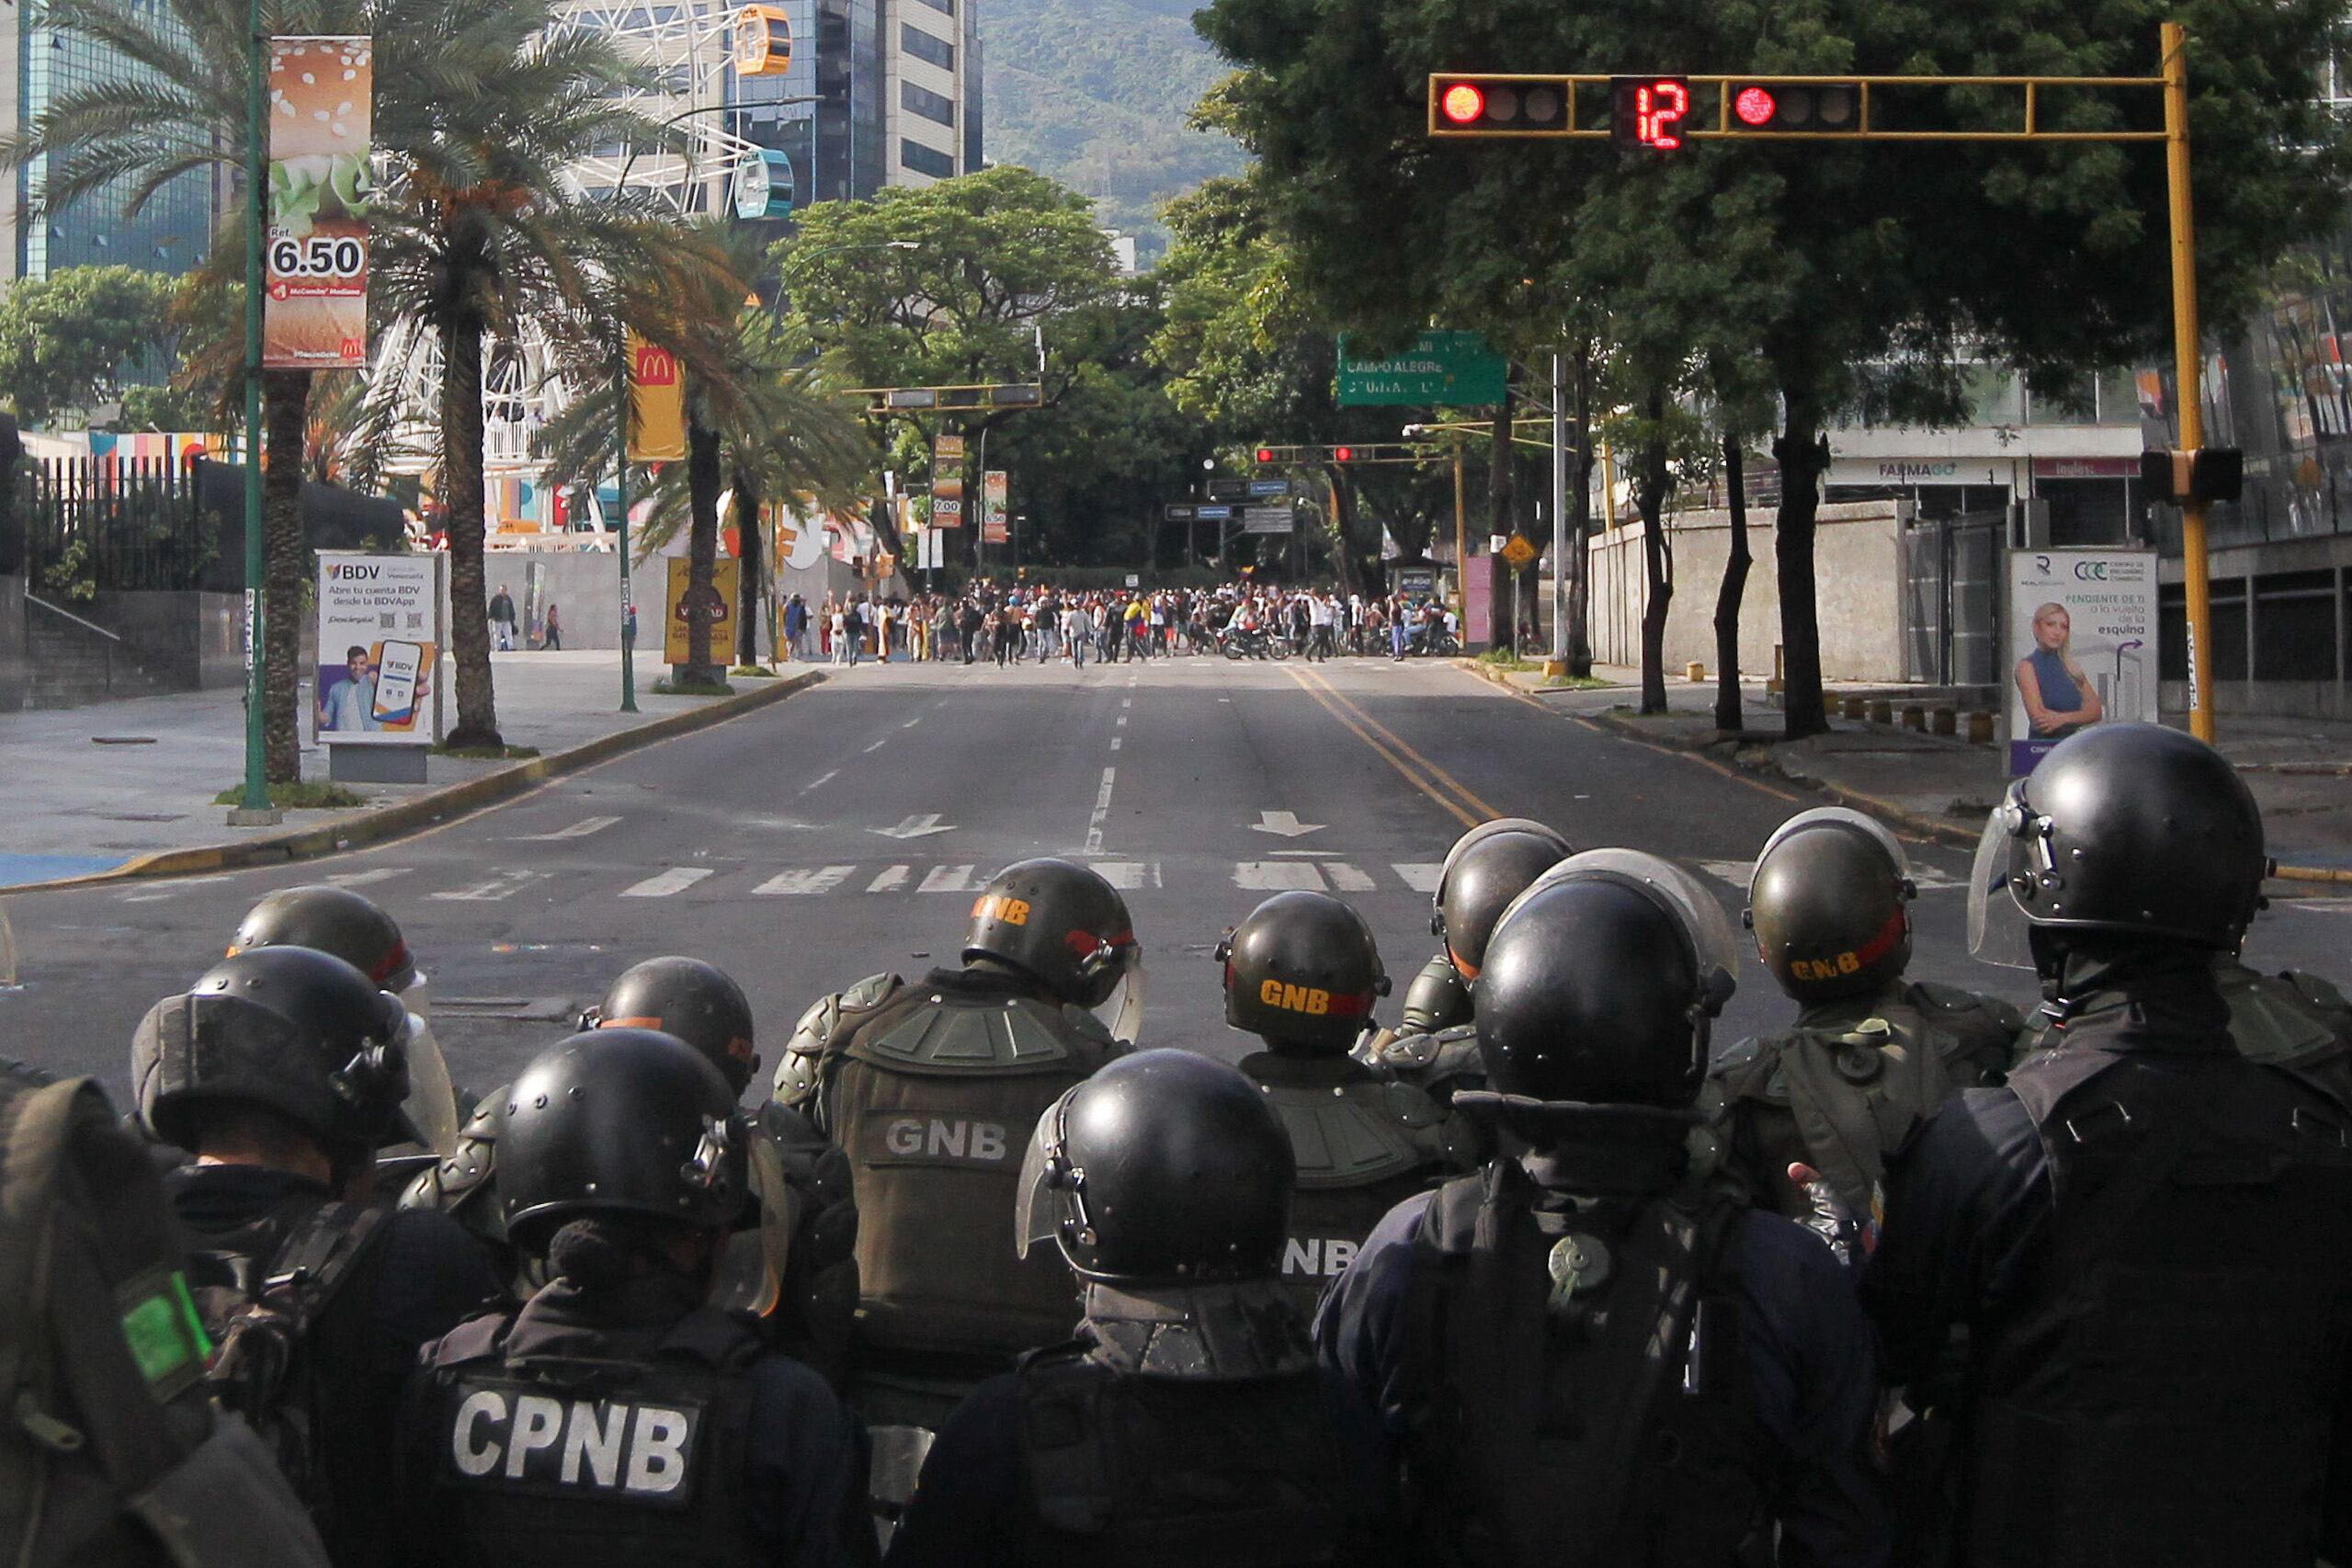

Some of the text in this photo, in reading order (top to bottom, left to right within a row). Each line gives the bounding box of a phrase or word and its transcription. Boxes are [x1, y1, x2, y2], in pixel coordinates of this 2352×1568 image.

[1635, 81, 1688, 150] 12
[273, 240, 361, 274] 6.50
[936, 502, 958, 512] 7.00
[343, 565, 380, 580] BDV
[365, 586, 396, 595] cuenta
[398, 586, 420, 595] BDV
[334, 597, 361, 606] desde
[2065, 595, 2118, 604] PENDIENTE
[2121, 595, 2133, 604] DE
[2113, 605, 2145, 614] vuelta
[2097, 624, 2145, 636] esquina
[1261, 980, 1330, 1016] GNB
[885, 1119, 1007, 1161] GNB
[452, 1390, 689, 1493] CPNB
